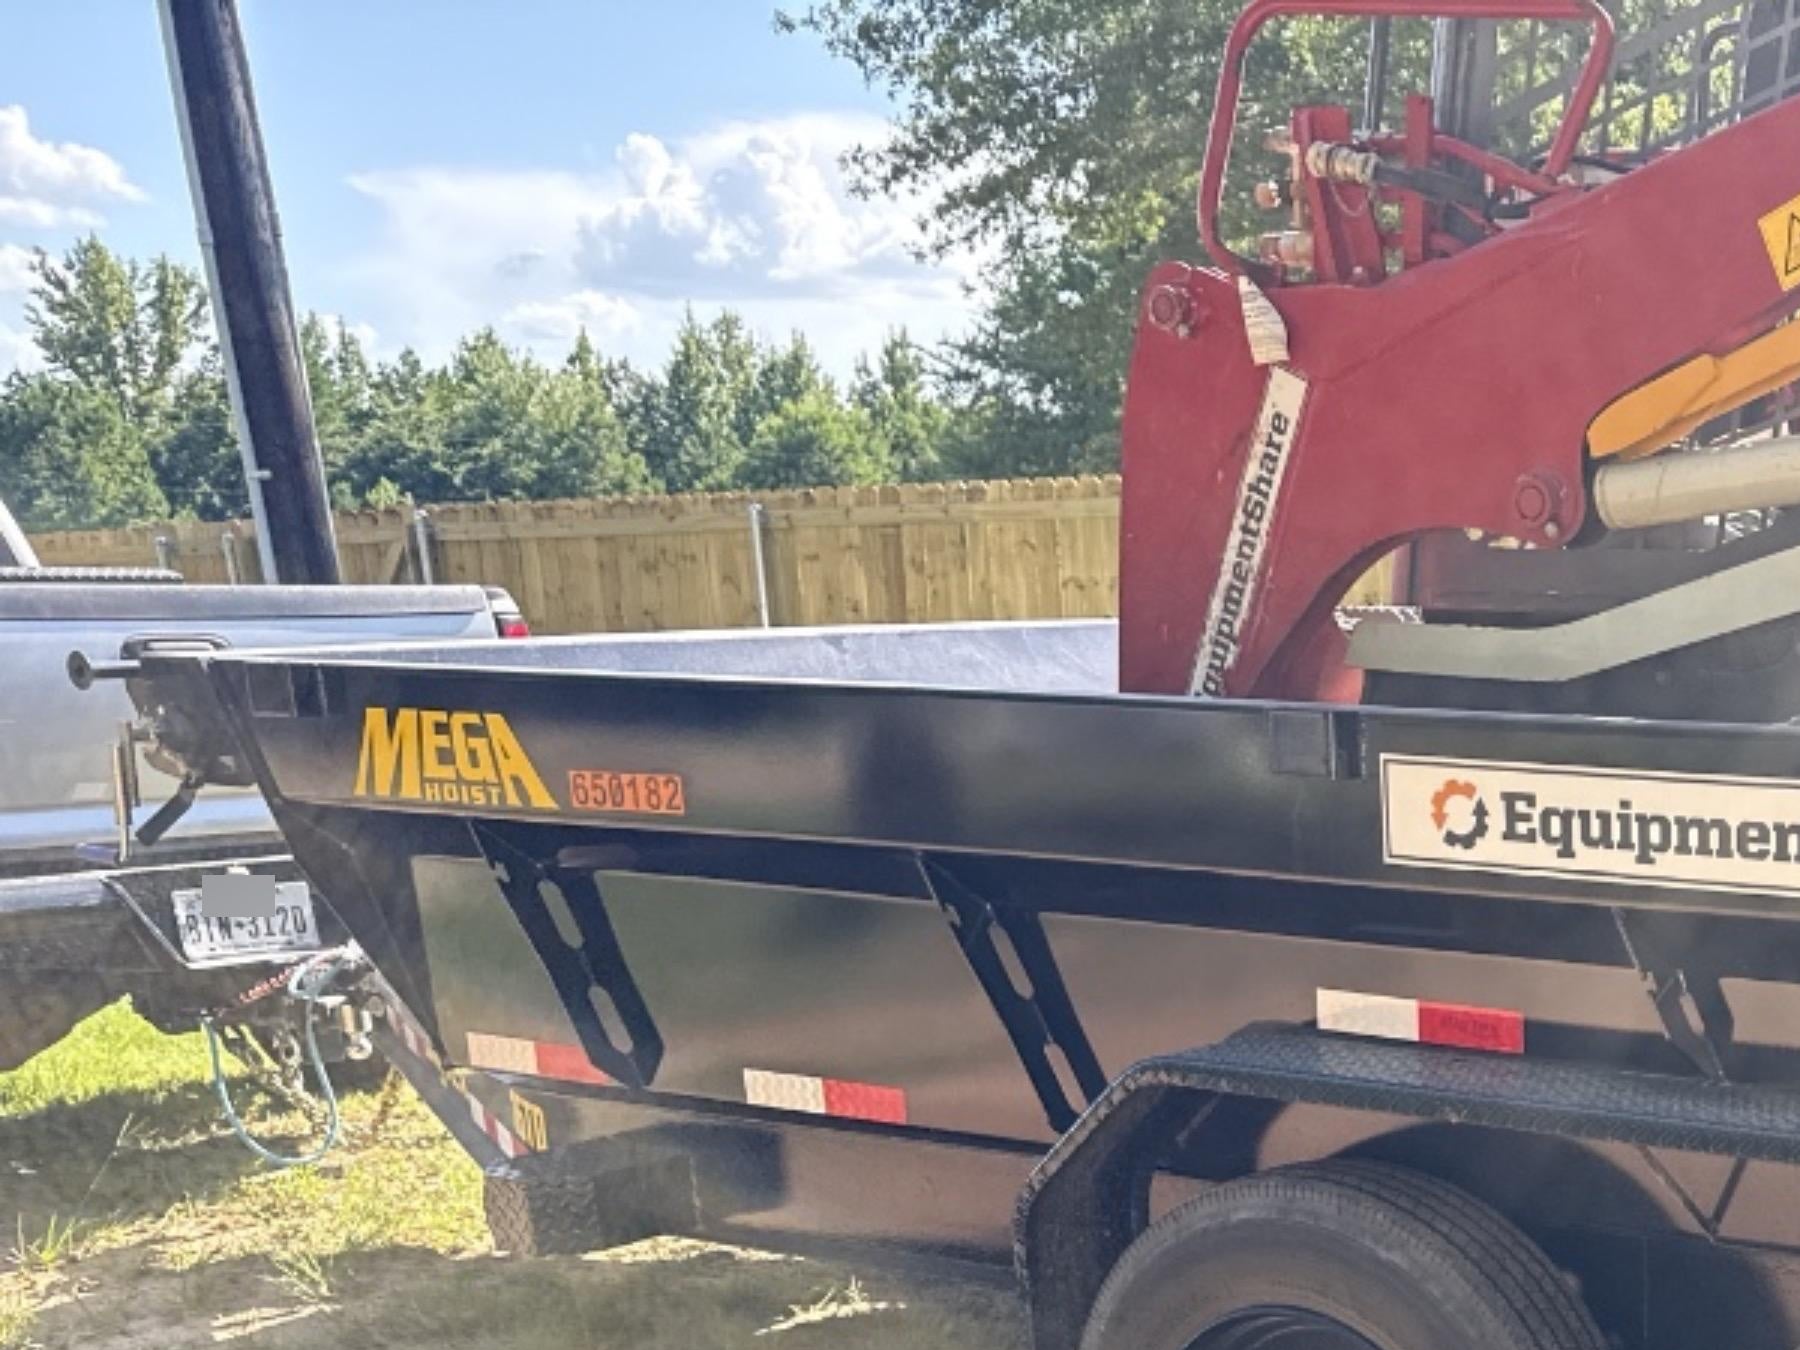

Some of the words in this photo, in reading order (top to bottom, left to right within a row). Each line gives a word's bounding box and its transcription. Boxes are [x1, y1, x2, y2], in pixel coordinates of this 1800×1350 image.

[1194, 411, 1289, 697] quipmentShare
[354, 707, 560, 811] MEGA
[425, 783, 501, 806] HOIST
[571, 773, 683, 811] 650182
